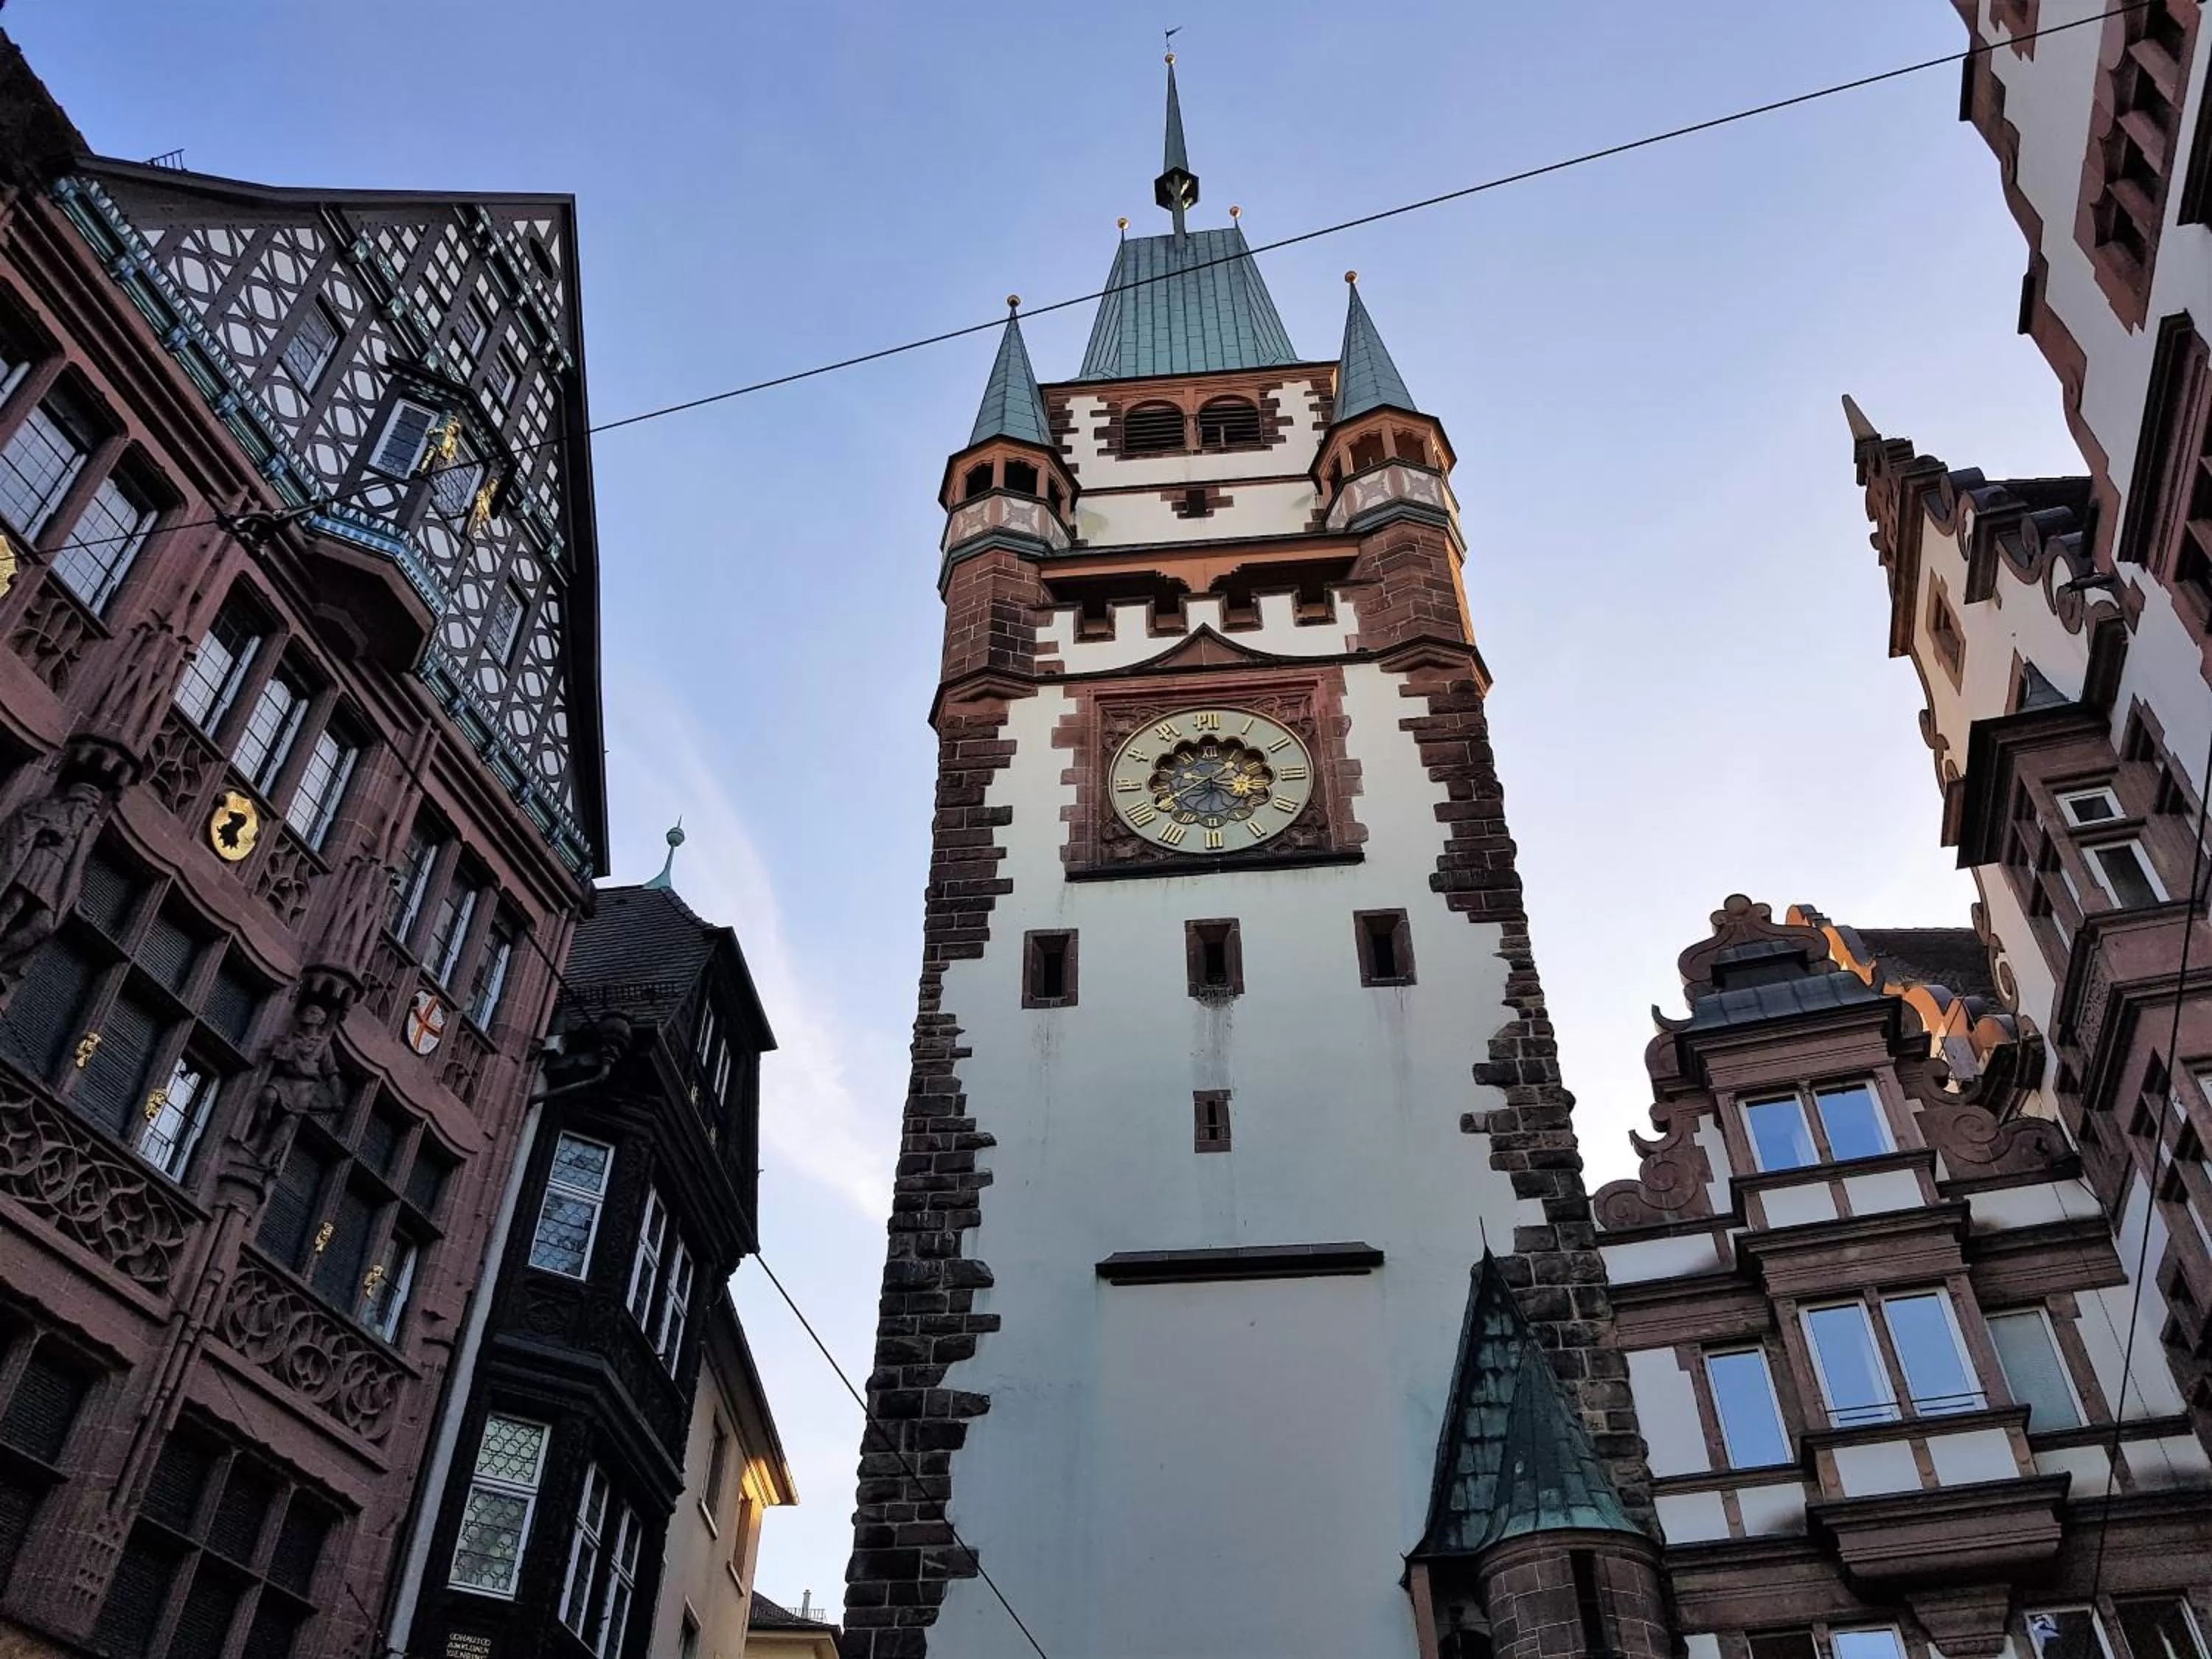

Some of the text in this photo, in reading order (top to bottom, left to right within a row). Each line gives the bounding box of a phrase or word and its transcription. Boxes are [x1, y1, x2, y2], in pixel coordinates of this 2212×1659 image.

[1242, 719, 1254, 734] I
[1268, 737, 1291, 752] II
[1281, 767, 1306, 780] III
